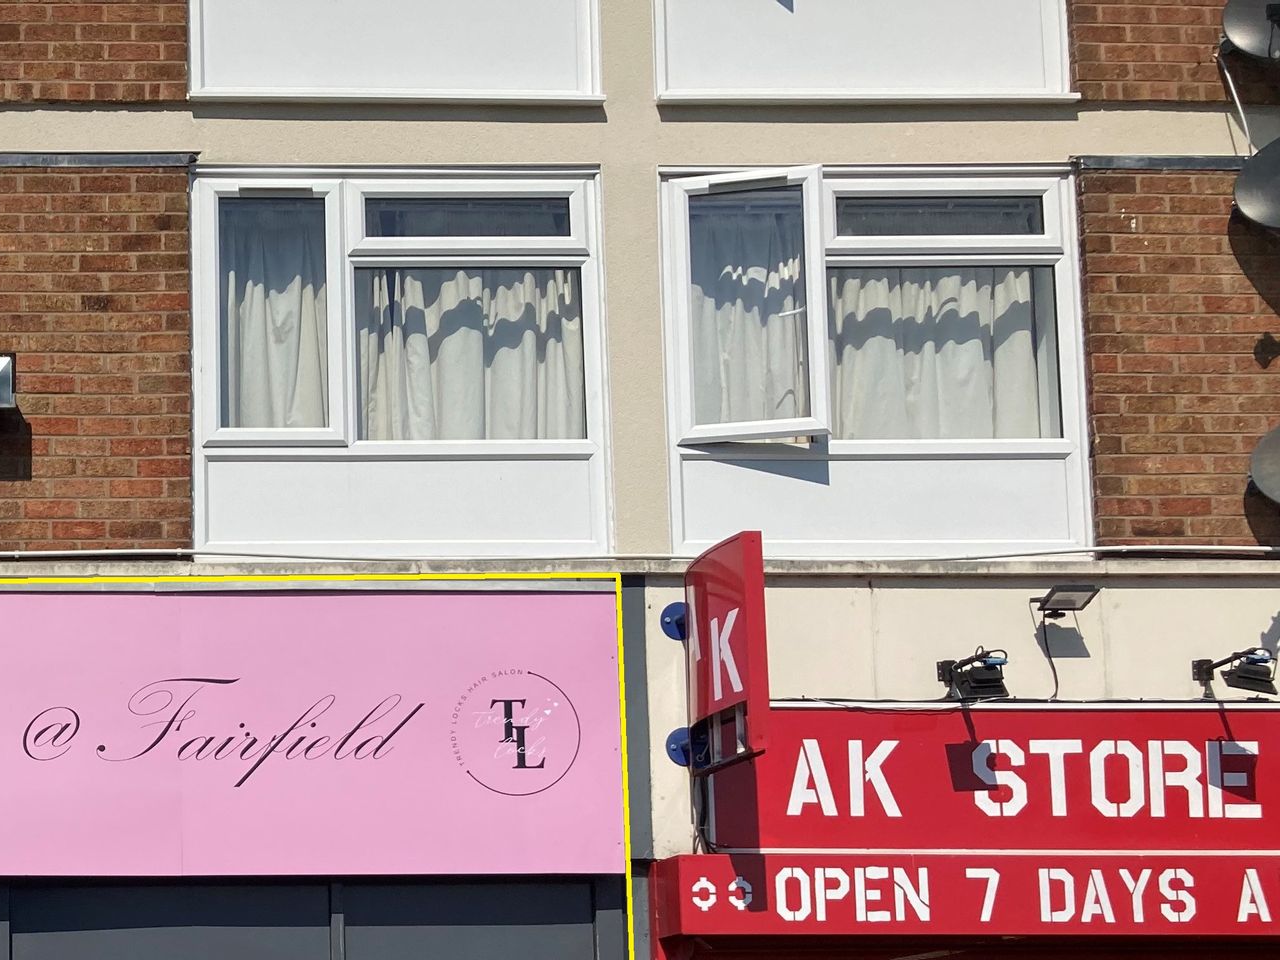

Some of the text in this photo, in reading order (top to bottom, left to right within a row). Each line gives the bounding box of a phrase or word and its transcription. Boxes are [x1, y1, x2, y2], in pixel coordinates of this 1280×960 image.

[22, 706, 81, 762] @
[96, 677, 427, 788] Fairfield
[450, 668, 523, 767] TRENDY LOCKS HAIR SALON
[786, 738, 1263, 819] AK STORE
[775, 866, 1273, 923] OPEN 7 DAYS A
